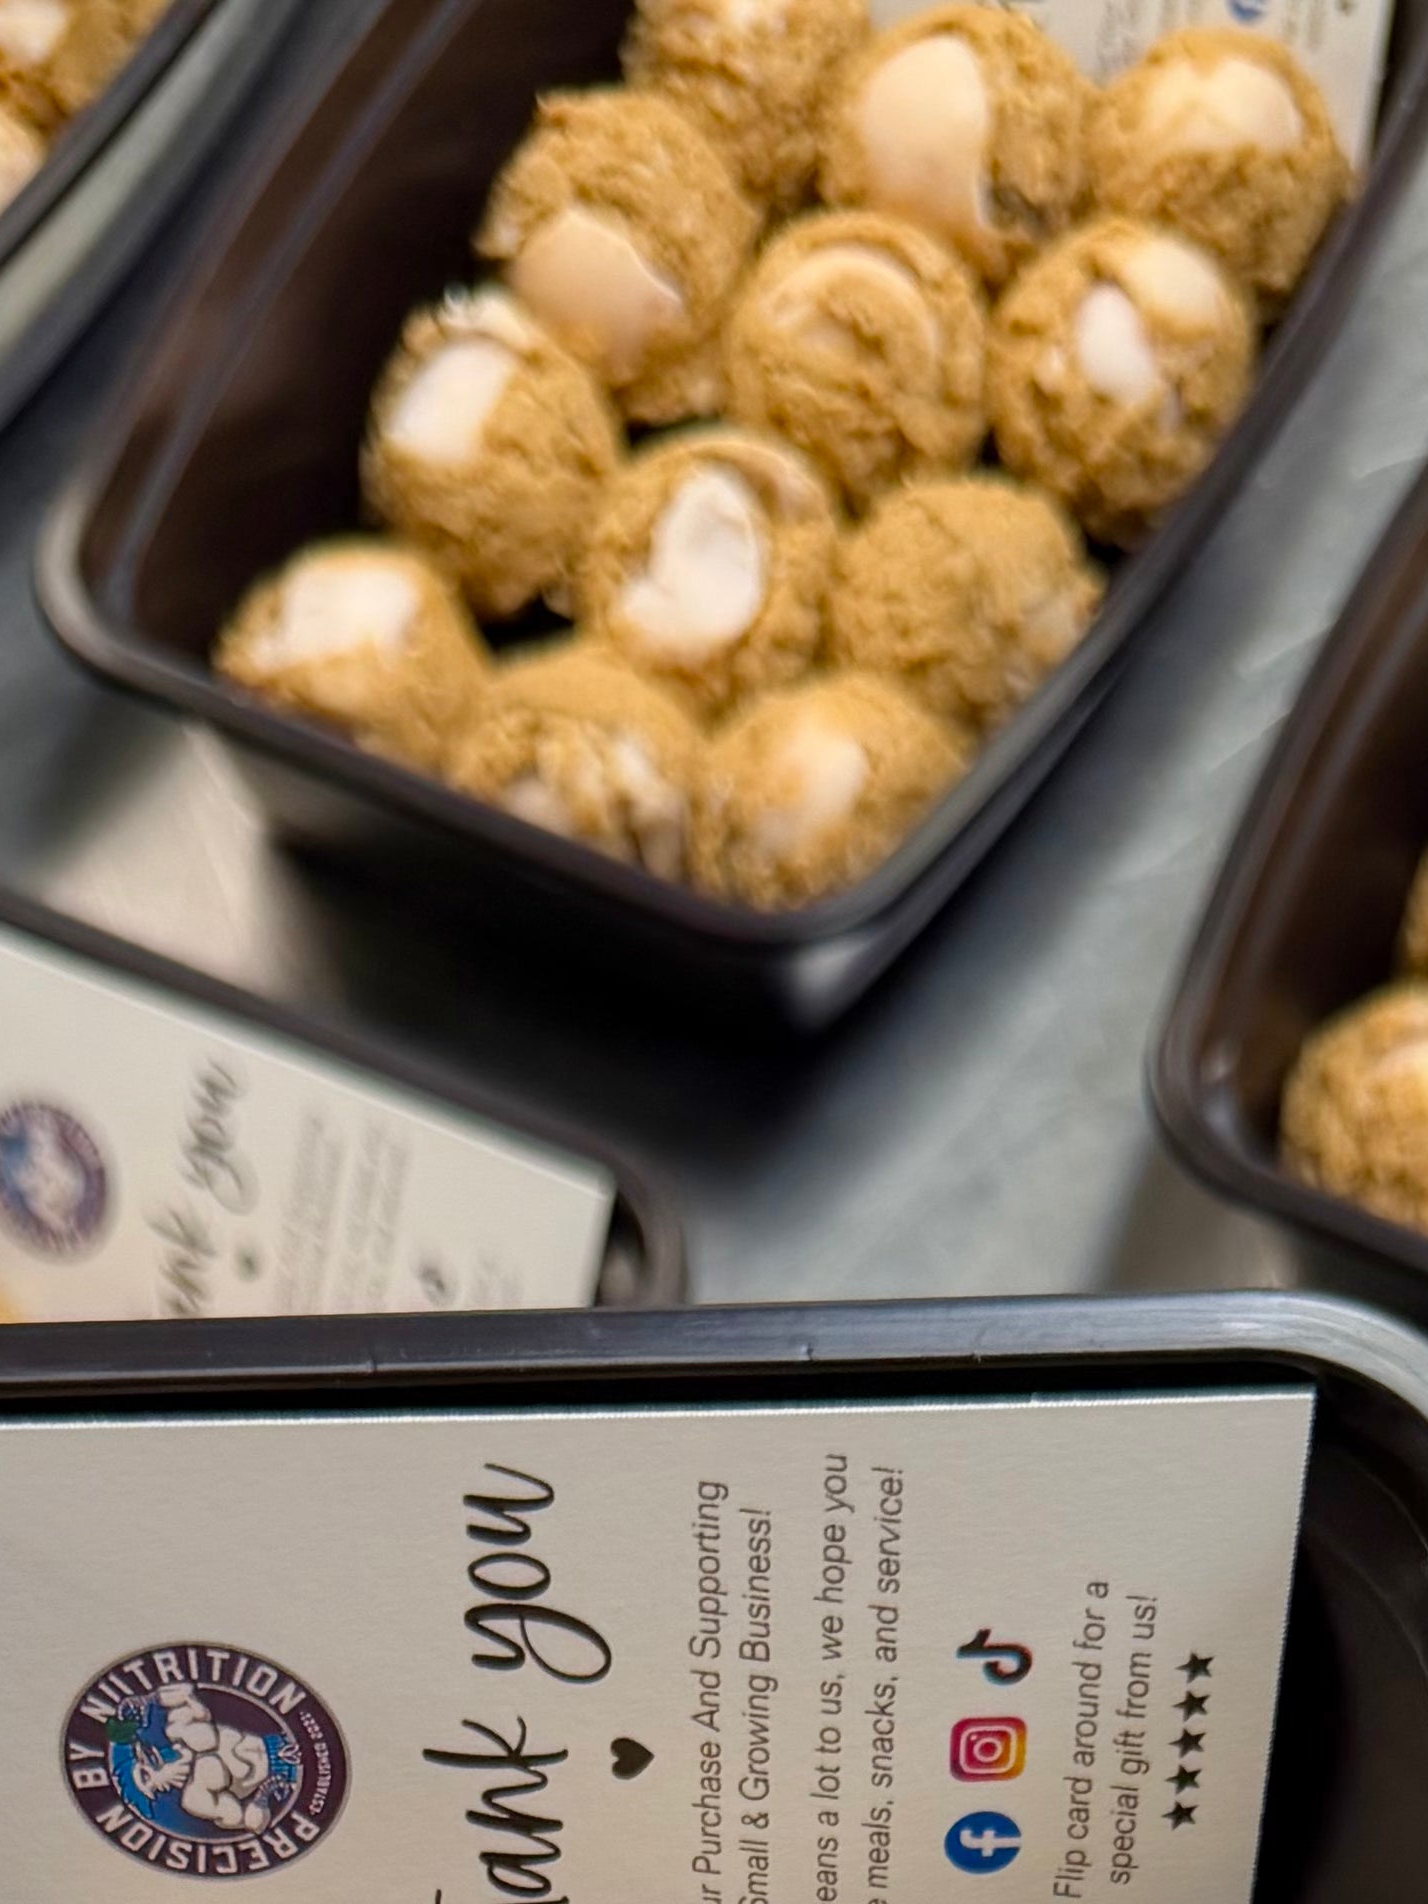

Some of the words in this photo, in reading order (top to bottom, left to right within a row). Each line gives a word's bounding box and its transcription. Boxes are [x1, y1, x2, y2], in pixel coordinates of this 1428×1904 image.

[824, 1453, 855, 1513] you
[871, 1466, 904, 1594] service!
[463, 1462, 612, 1684] you
[688, 1480, 729, 1660] Supporting
[738, 1507, 772, 1663] Business!
[813, 1523, 853, 1603] hope
[1086, 1581, 1109, 1599] a
[821, 1614, 844, 1661] we
[868, 1604, 899, 1663] and
[1073, 1607, 1107, 1651] for
[1125, 1594, 1159, 1640] us!
[689, 1669, 721, 1733] And
[820, 1674, 845, 1716] us,
[1071, 1661, 1103, 1768] around
[1115, 1652, 1152, 1719] from
[738, 1674, 779, 1801] Growing
[815, 1727, 841, 1754] to
[864, 1676, 899, 1788] snacks,
[1113, 1730, 1150, 1776] gift
[68, 1743, 111, 1790] BY
[810, 1765, 841, 1800] lot
[691, 1741, 723, 1875] Purchase
[740, 1811, 770, 1829] &
[817, 1810, 840, 1826] a
[1063, 1776, 1092, 1840] card
[1109, 1785, 1139, 1886] special
[95, 1807, 321, 1875] PRECISION
[861, 1800, 894, 1888] meals,
[1053, 1849, 1091, 1899] Flip
